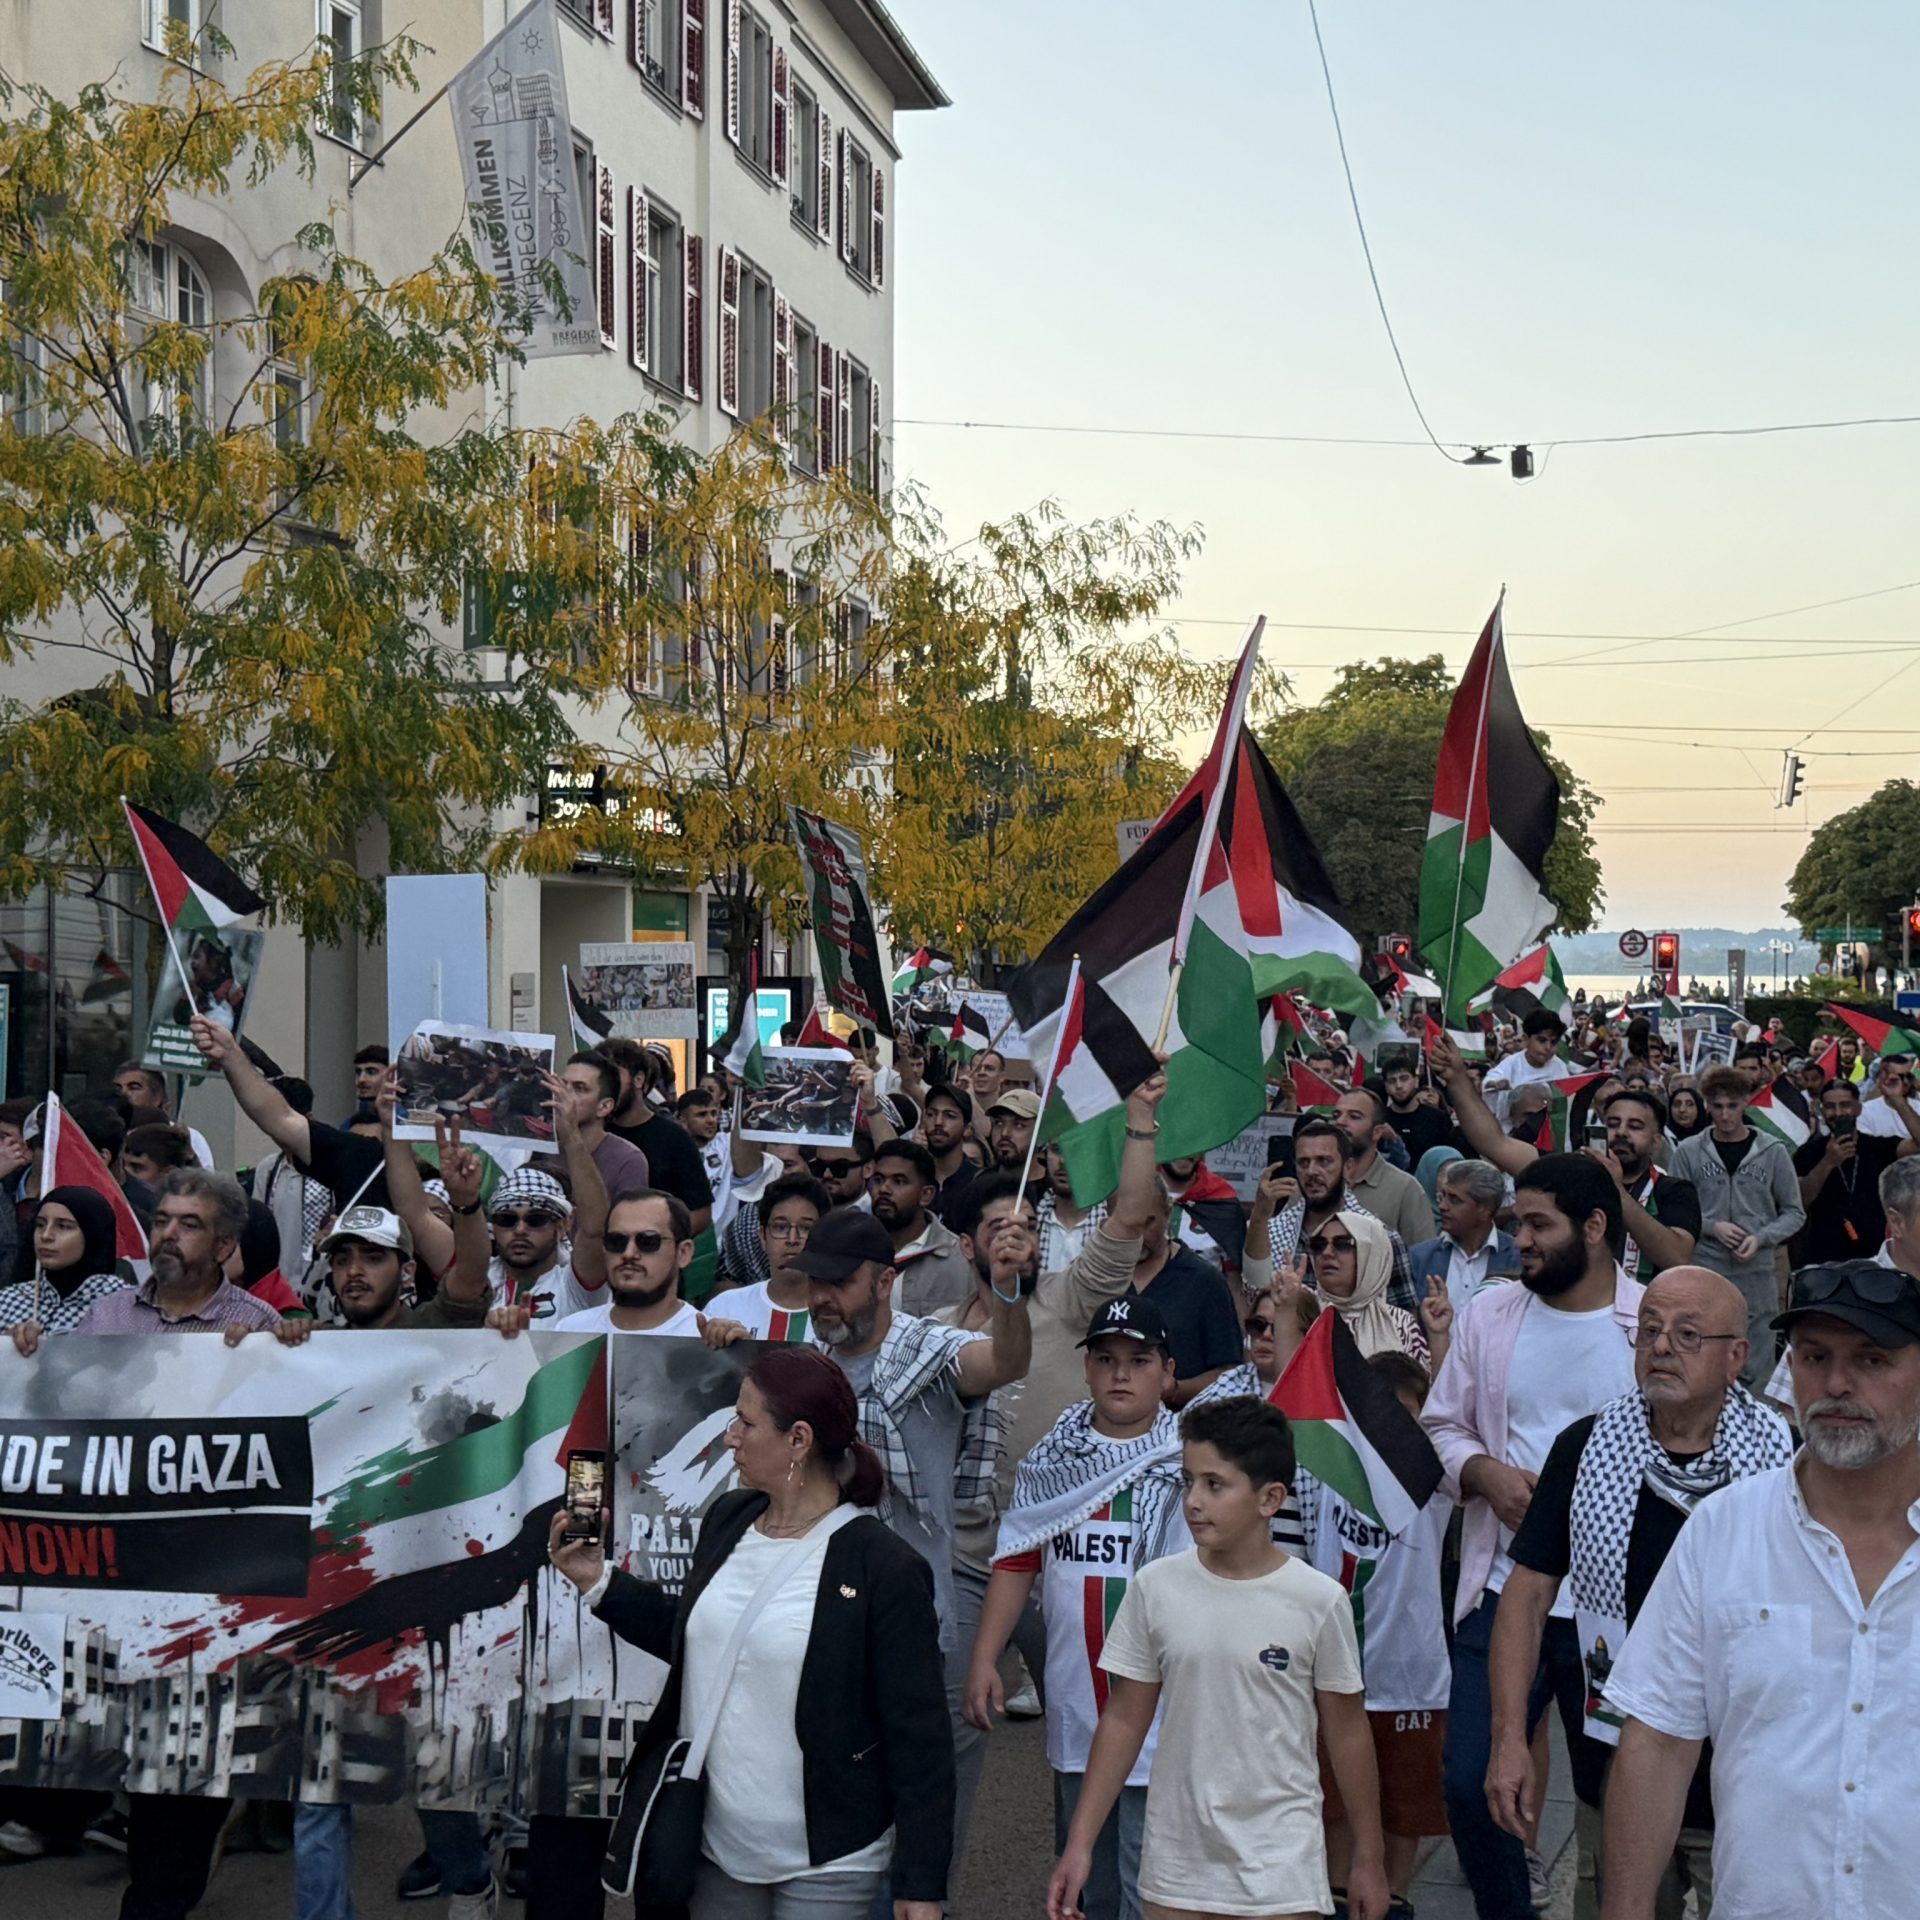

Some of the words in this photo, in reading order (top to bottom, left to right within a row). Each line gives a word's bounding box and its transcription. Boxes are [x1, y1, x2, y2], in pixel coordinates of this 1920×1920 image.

[506, 174, 542, 287] BREGENZ
[1107, 1301, 1131, 1321] NY
[0, 1435, 71, 1495] DE
[81, 1435, 133, 1496] IN
[147, 1433, 282, 1495] GAZA
[0, 1520, 120, 1578] NOW!
[1052, 1532, 1132, 1565] PALEST
[1394, 1711, 1433, 1733] GAP
